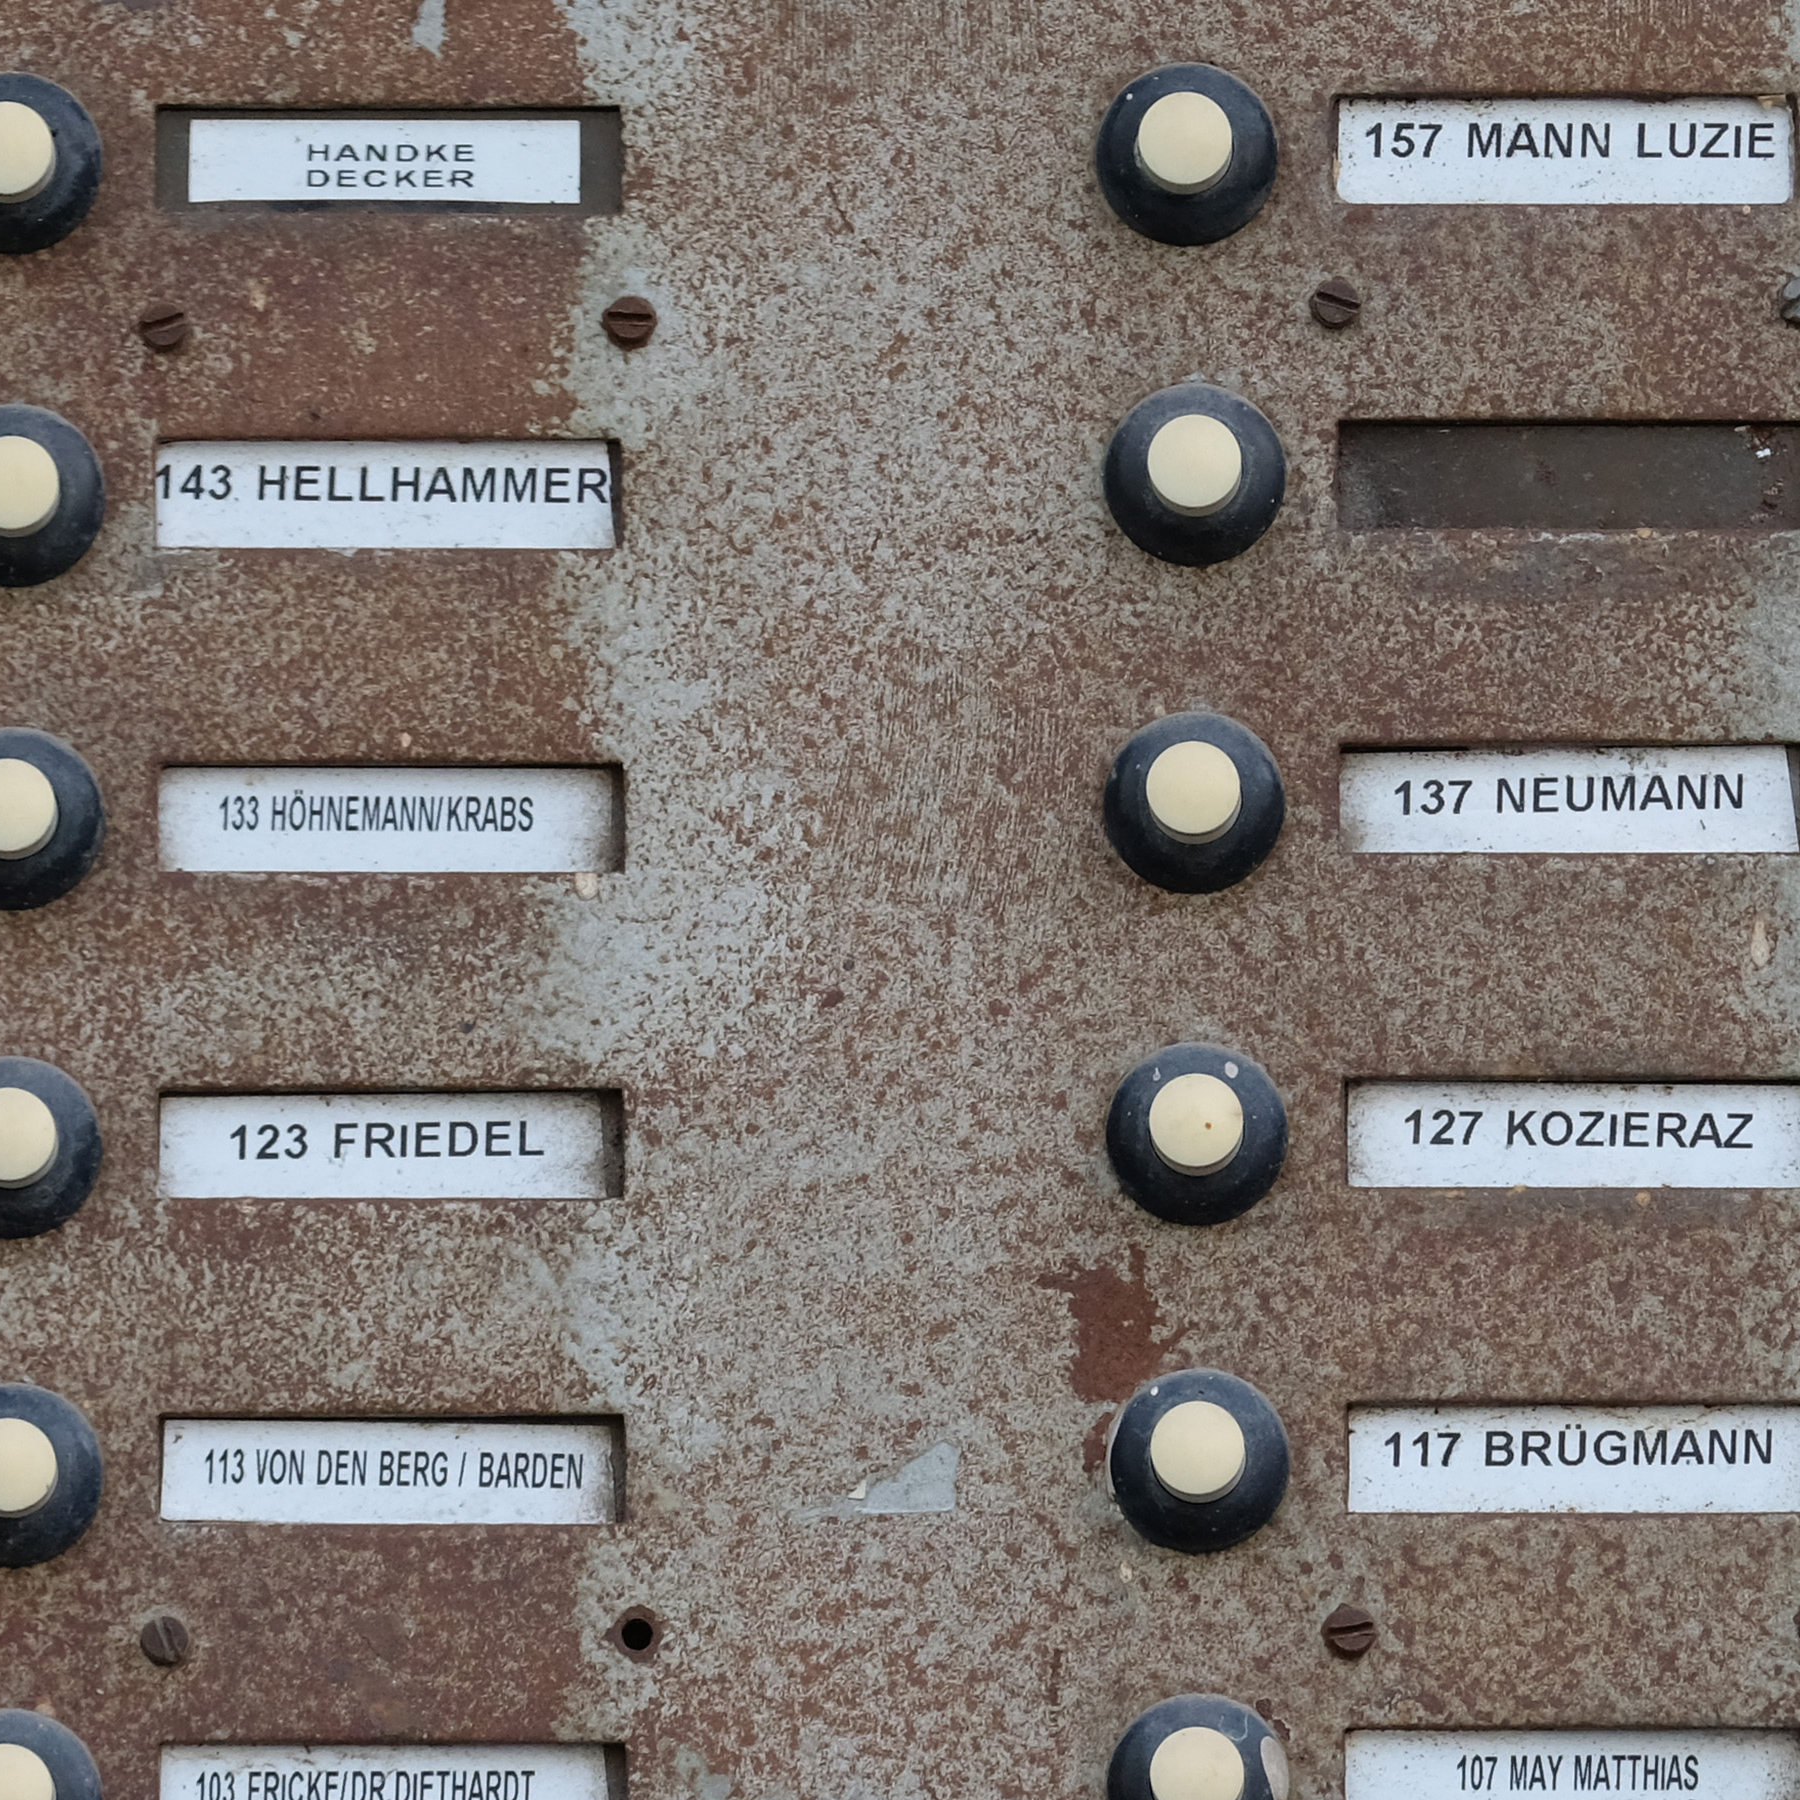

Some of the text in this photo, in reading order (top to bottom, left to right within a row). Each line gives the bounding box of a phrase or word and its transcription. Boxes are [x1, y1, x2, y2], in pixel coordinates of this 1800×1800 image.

[307, 143, 474, 162] HANDKE
[1364, 122, 1776, 160] 157 MANN LUZIE
[307, 170, 474, 189] DECKER
[156, 465, 608, 504] 143 HELLHAMMER
[218, 789, 534, 833] 133 HÖHNEMANN/KRABS
[1392, 774, 1744, 816] 137 NEUMANN
[229, 1121, 544, 1160] 123 FRIEDEL
[1404, 1110, 1753, 1149] 127 KOZIERAZ
[1383, 1421, 1774, 1468] 117 BRÜGMANN
[204, 1449, 584, 1490] 113 VON DEN BERG / BARDEN
[1455, 1754, 1698, 1792] 107 MAY MATTHIAS
